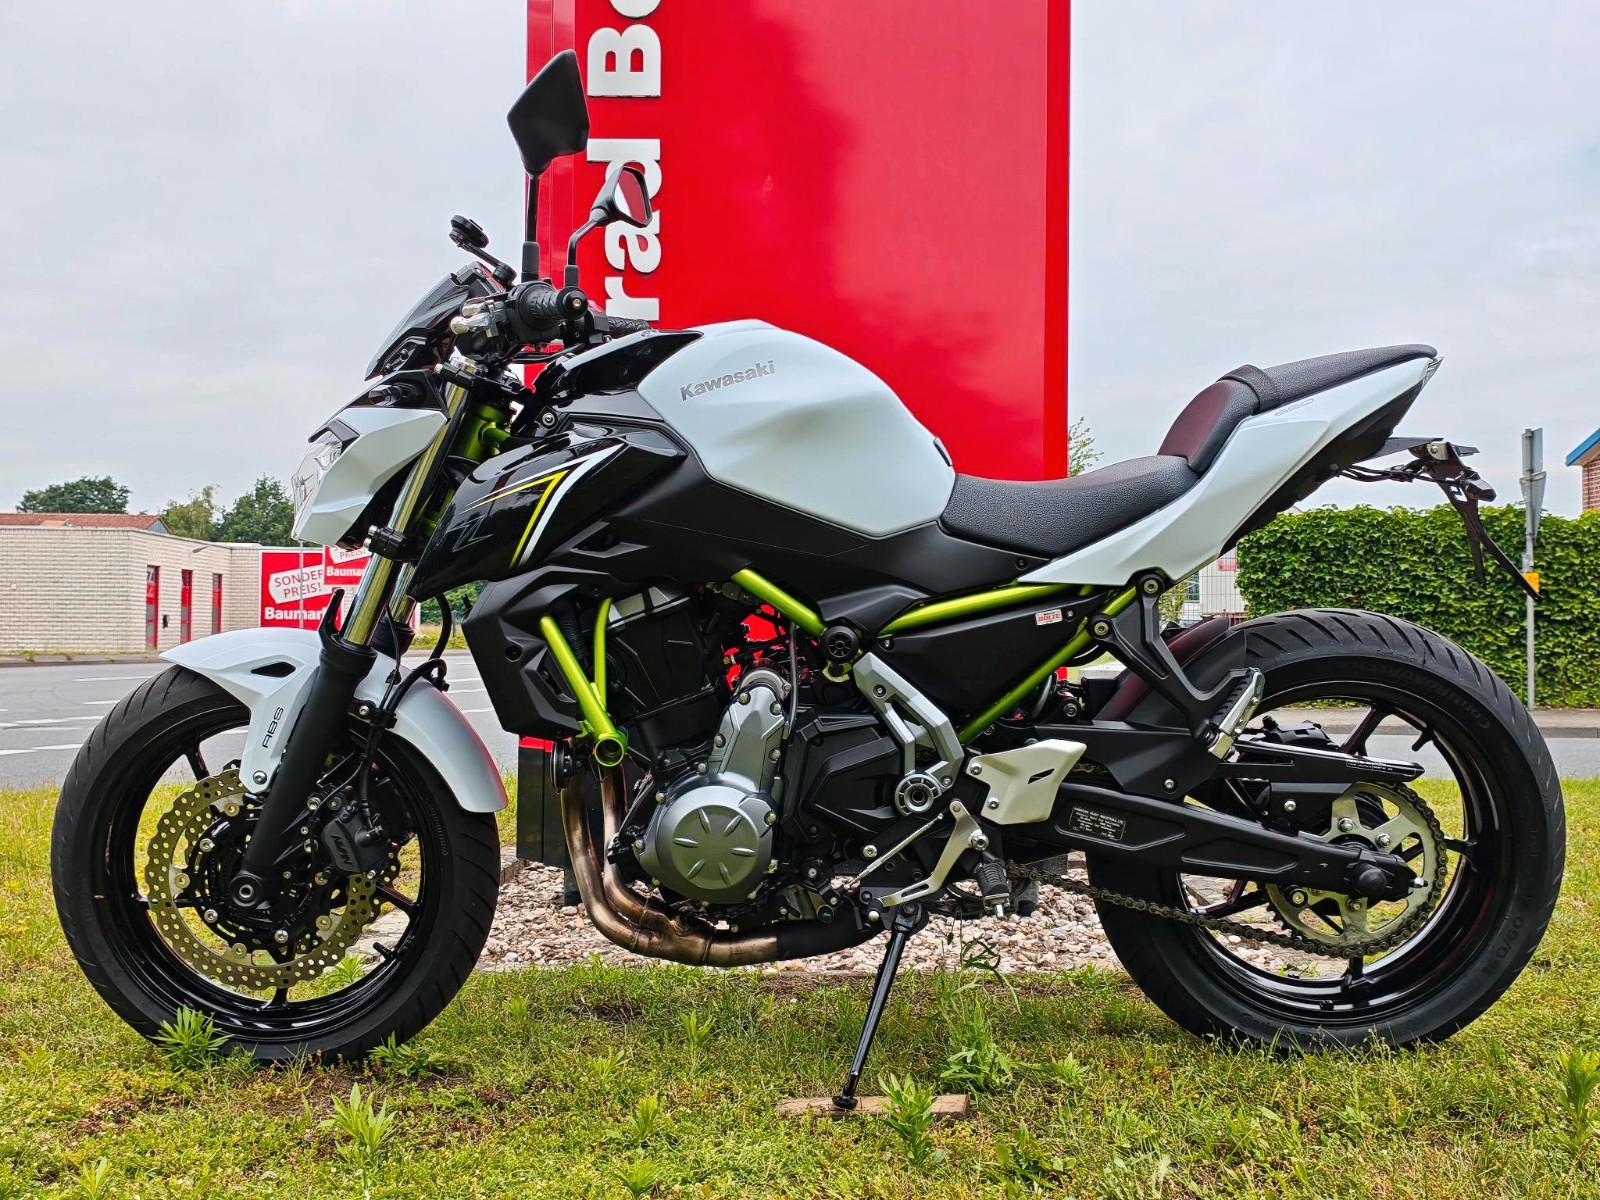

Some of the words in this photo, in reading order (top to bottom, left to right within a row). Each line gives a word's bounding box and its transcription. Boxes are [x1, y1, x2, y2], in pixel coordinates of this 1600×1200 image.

[680, 360, 775, 401] Kawasaki
[283, 582, 322, 598] PREIS!
[262, 706, 284, 748] ABS
